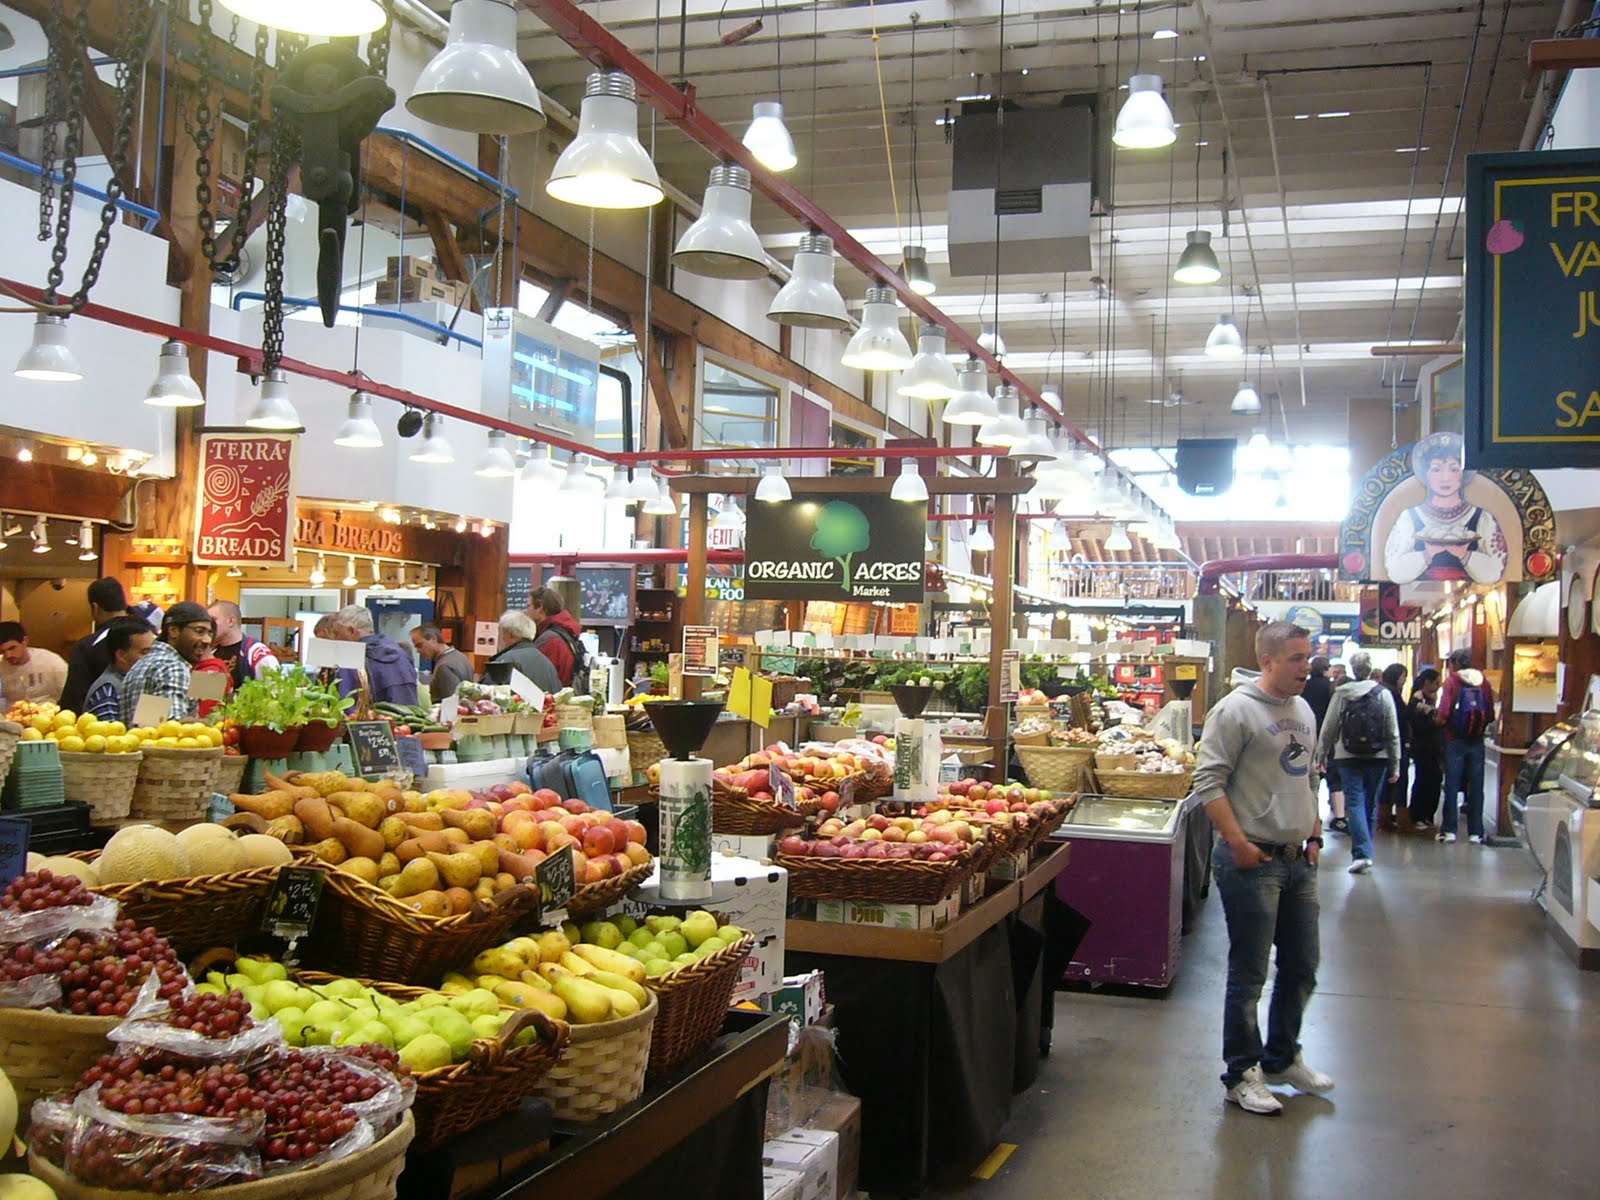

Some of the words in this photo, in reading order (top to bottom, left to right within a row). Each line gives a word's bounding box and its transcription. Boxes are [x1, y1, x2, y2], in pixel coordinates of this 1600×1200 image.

[213, 441, 283, 461] TERRA
[201, 536, 281, 557] BREADS
[333, 523, 402, 553] BREADS
[713, 529, 734, 546] EXIT
[748, 561, 834, 580] ORGANIC
[853, 561, 921, 581] ACRES
[852, 585, 891, 597] Market
